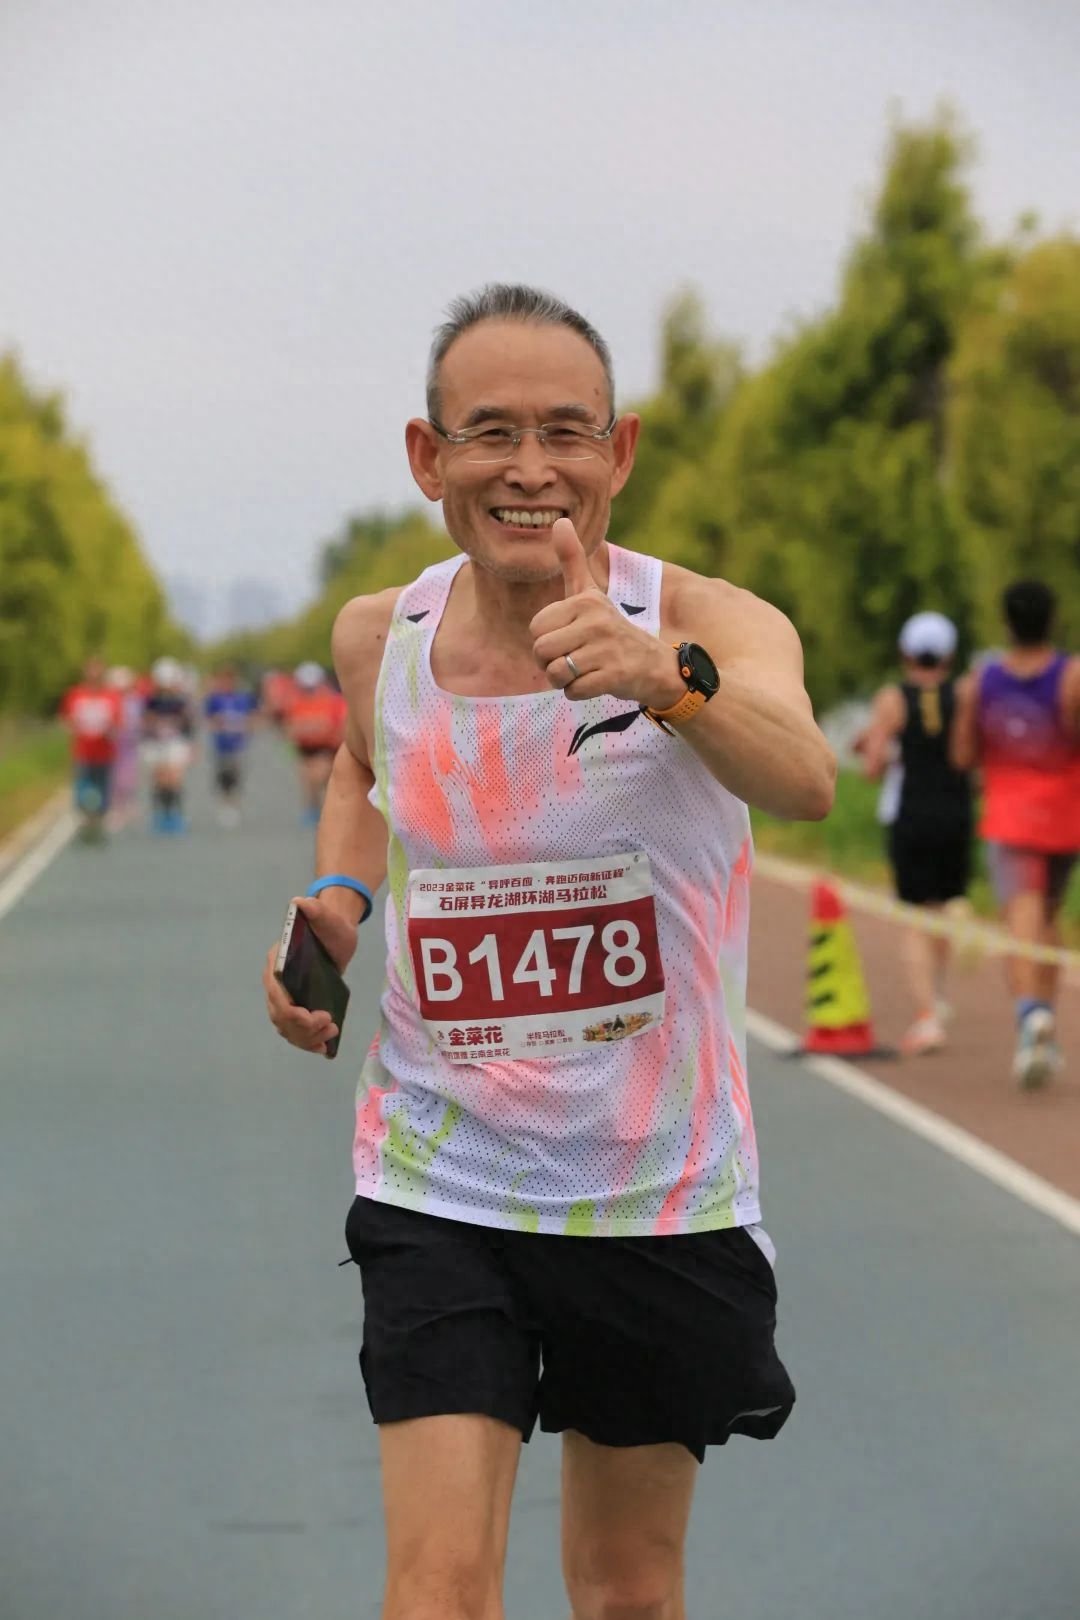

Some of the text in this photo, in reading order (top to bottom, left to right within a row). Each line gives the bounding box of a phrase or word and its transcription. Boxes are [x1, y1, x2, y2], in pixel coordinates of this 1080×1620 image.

[439, 885, 608, 911] 石屏异龙湖环湖马拉松
[420, 919, 647, 1002] B1478
[448, 1025, 503, 1046] 金菜花
